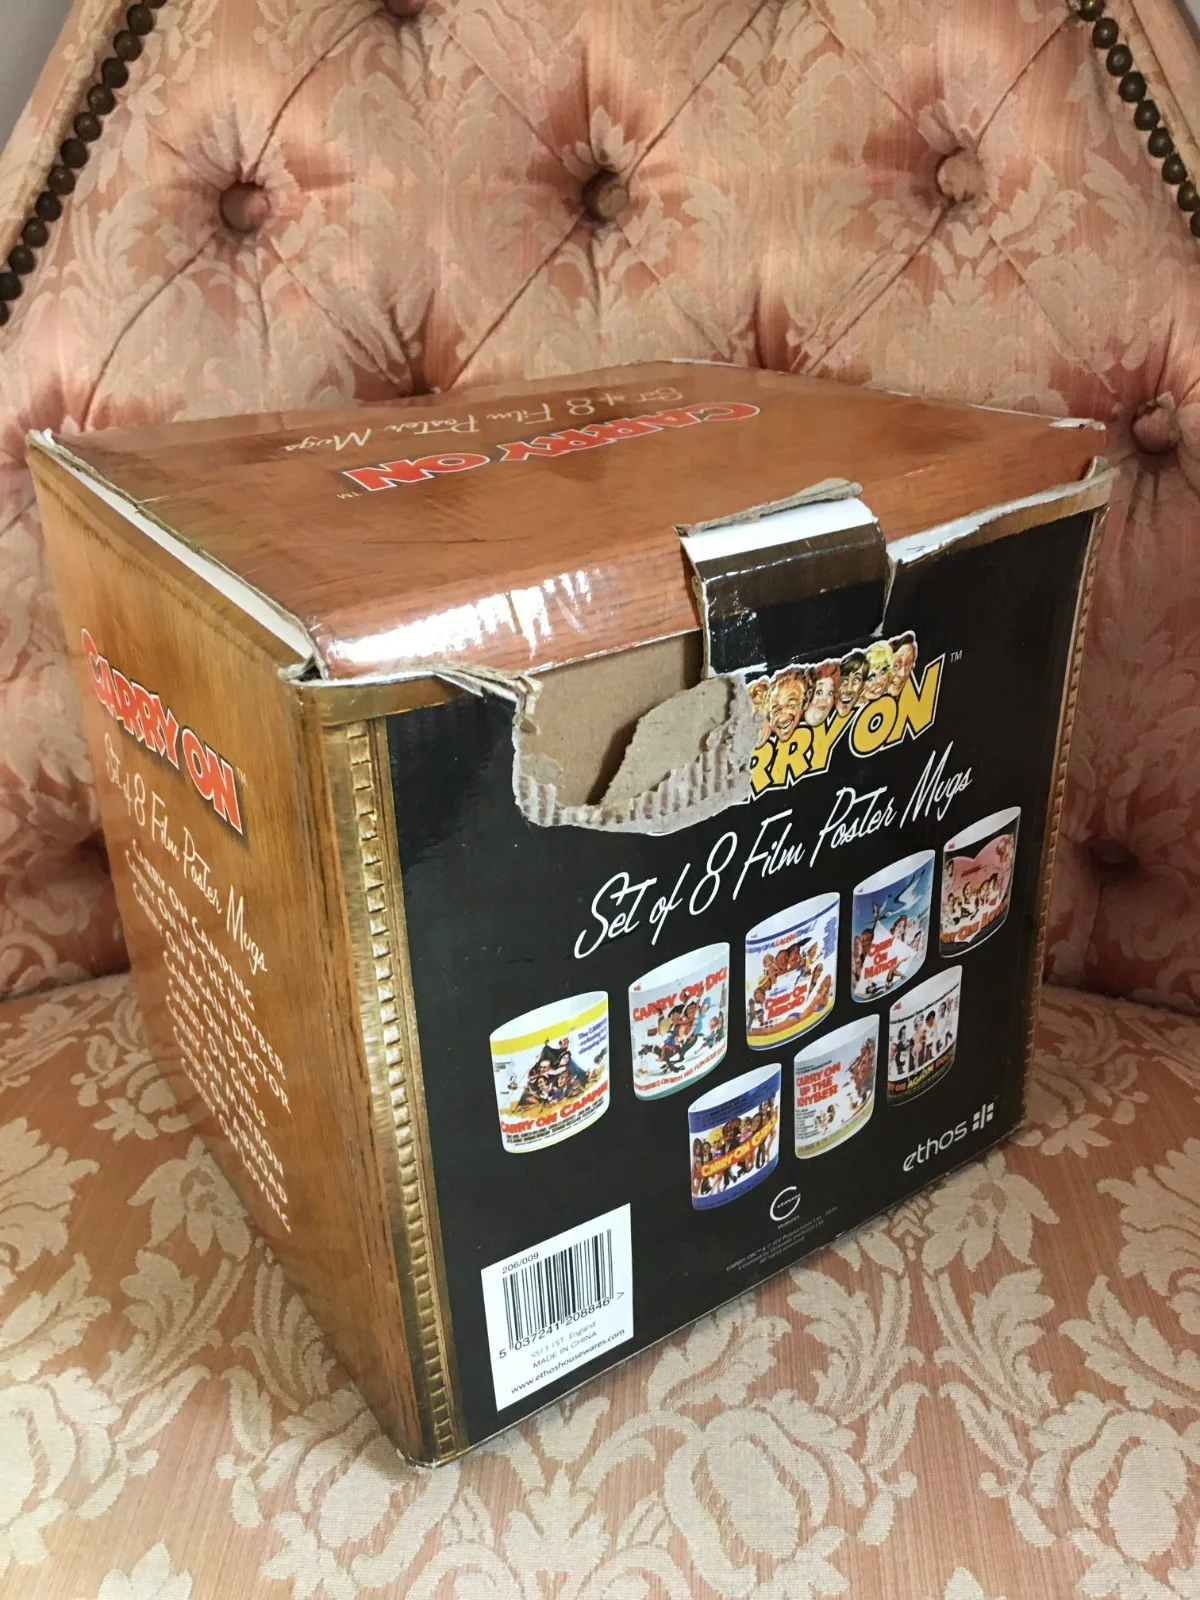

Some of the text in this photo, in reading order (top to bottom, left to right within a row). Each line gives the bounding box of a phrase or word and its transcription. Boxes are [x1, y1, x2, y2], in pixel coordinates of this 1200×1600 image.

[384, 413, 480, 438] Poster
[485, 402, 553, 426] Film
[566, 397, 595, 415] 8
[278, 428, 373, 453] Mugs
[496, 401, 762, 462] CARRY
[341, 452, 491, 492] ON
[81, 627, 180, 771] CARRY
[181, 727, 243, 836] ON
[748, 702, 856, 803] RRY
[849, 653, 945, 757] ON
[573, 740, 972, 959] Set of 8 Film Poster Mugs
[134, 772, 146, 826] 8
[151, 790, 181, 863] Film
[183, 826, 222, 914] Poster
[226, 884, 268, 976] Mugs
[535, 1112, 558, 1128] ON
[733, 1142, 751, 1158] ON
[903, 1120, 968, 1171] ethos
[502, 1252, 539, 1275] 206/009
[499, 1348, 507, 1359] 5
[514, 1322, 560, 1351] 037241
[565, 1299, 610, 1326] 208846
[569, 1321, 596, 1339] England
[510, 1329, 625, 1395] www.ethoshousewares.com
[533, 1331, 597, 1369] MADE IN CHINA
